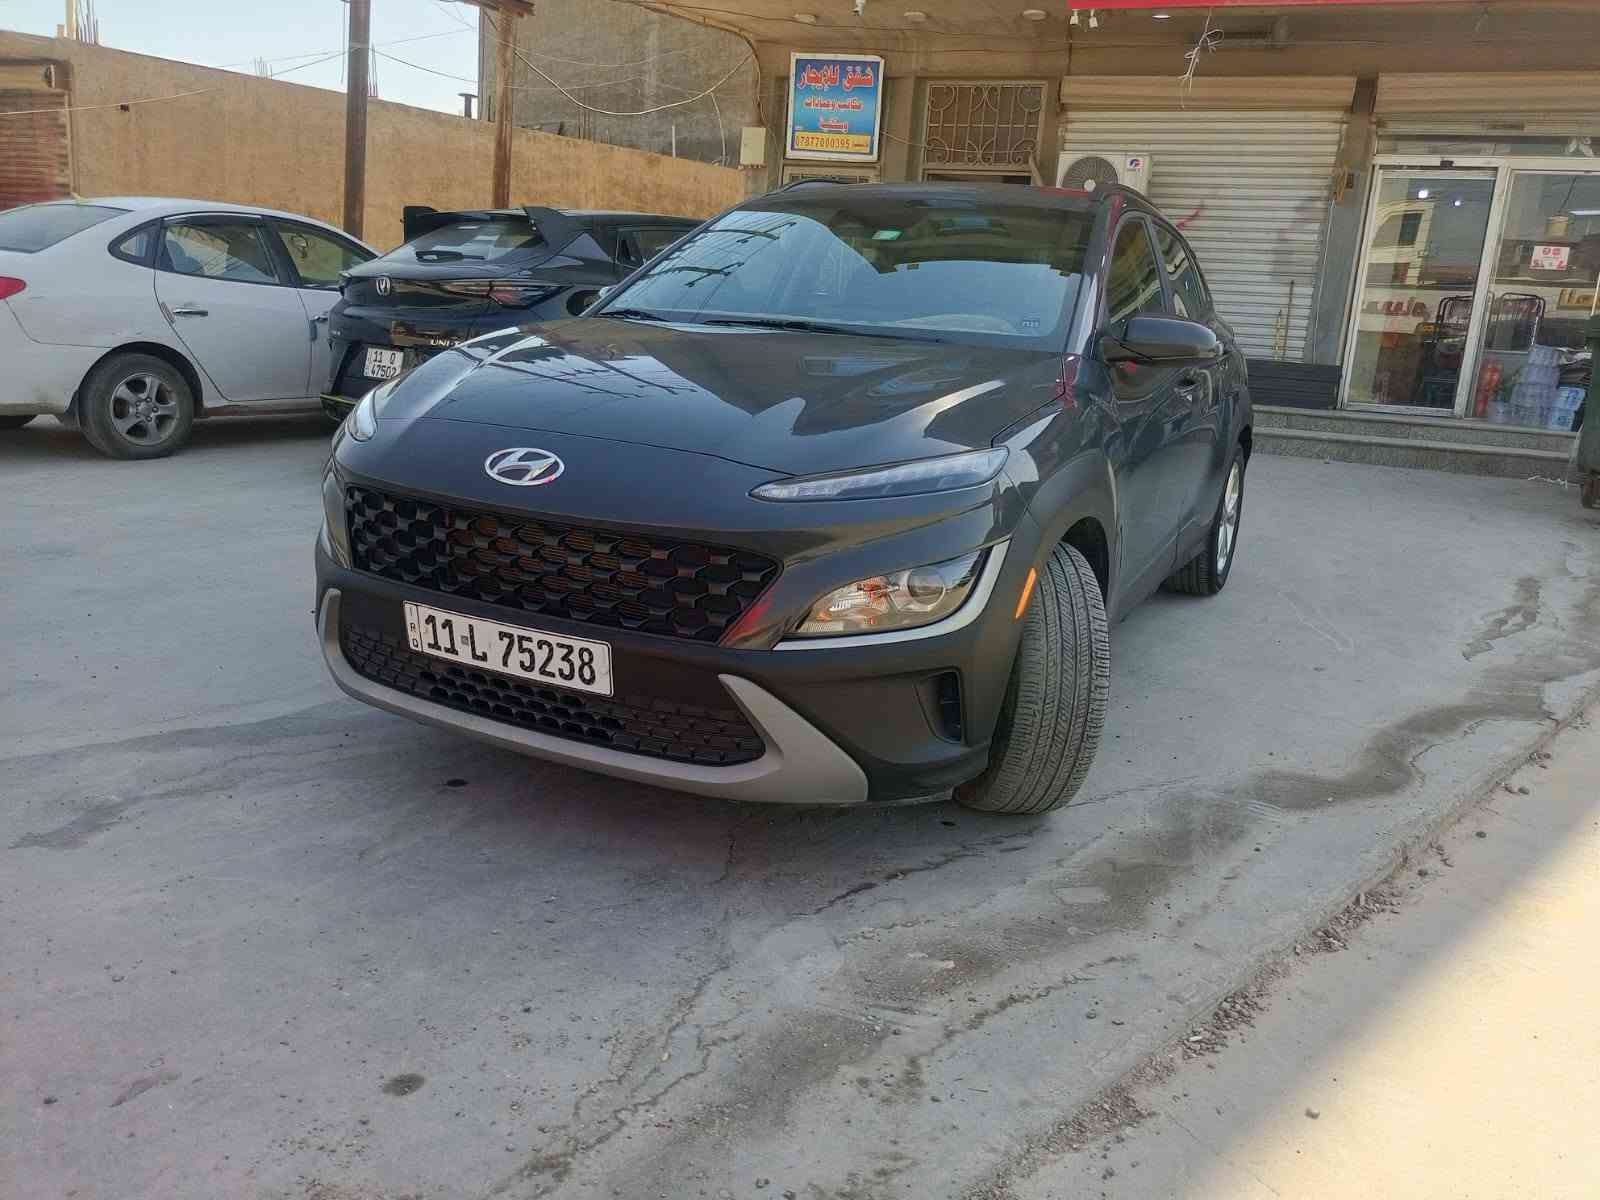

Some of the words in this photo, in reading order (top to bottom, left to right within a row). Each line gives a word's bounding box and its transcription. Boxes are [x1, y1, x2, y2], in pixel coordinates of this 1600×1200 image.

[843, 64, 873, 93] شقق
[373, 350, 383, 364] 11
[425, 614, 459, 656] 11
[469, 624, 488, 662] L
[498, 630, 597, 686] 75238
